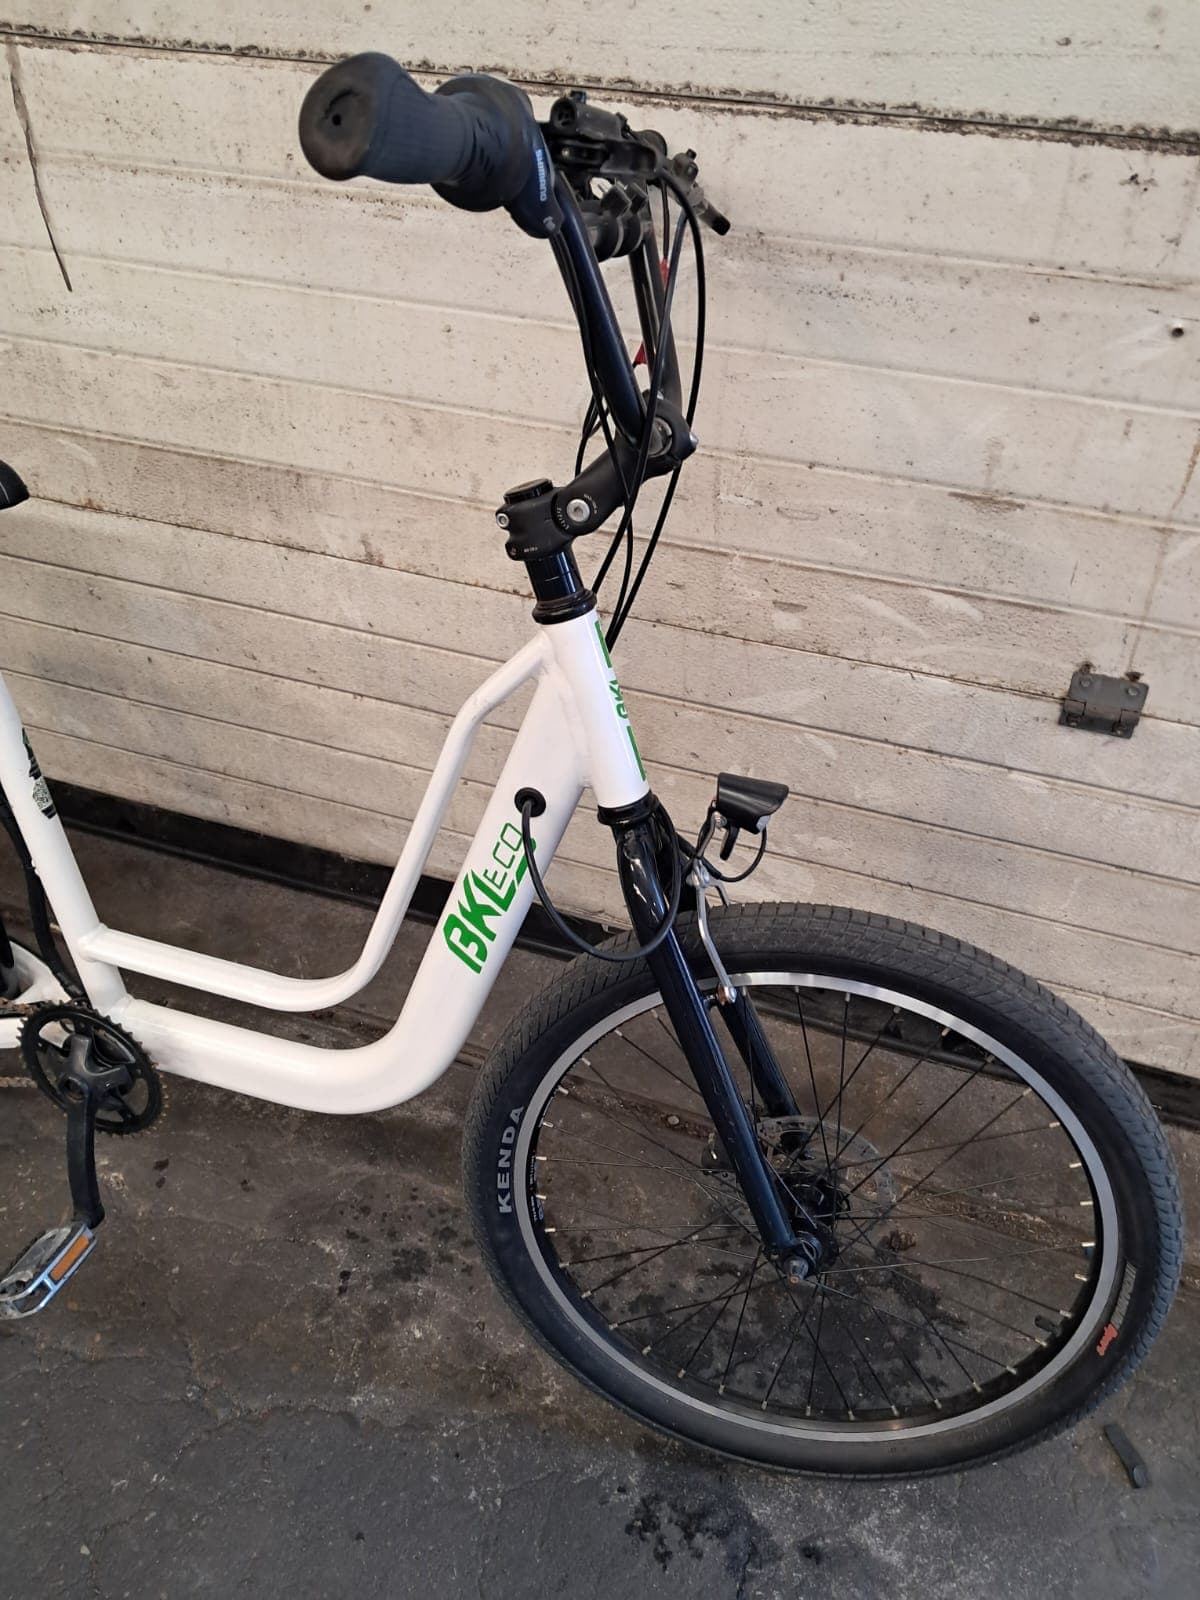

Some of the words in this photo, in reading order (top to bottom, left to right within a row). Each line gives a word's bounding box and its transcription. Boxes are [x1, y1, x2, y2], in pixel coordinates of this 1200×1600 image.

[536, 149, 547, 201] SHIMANO
[482, 822, 524, 890] ECO
[496, 1105, 525, 1214] KENDA
